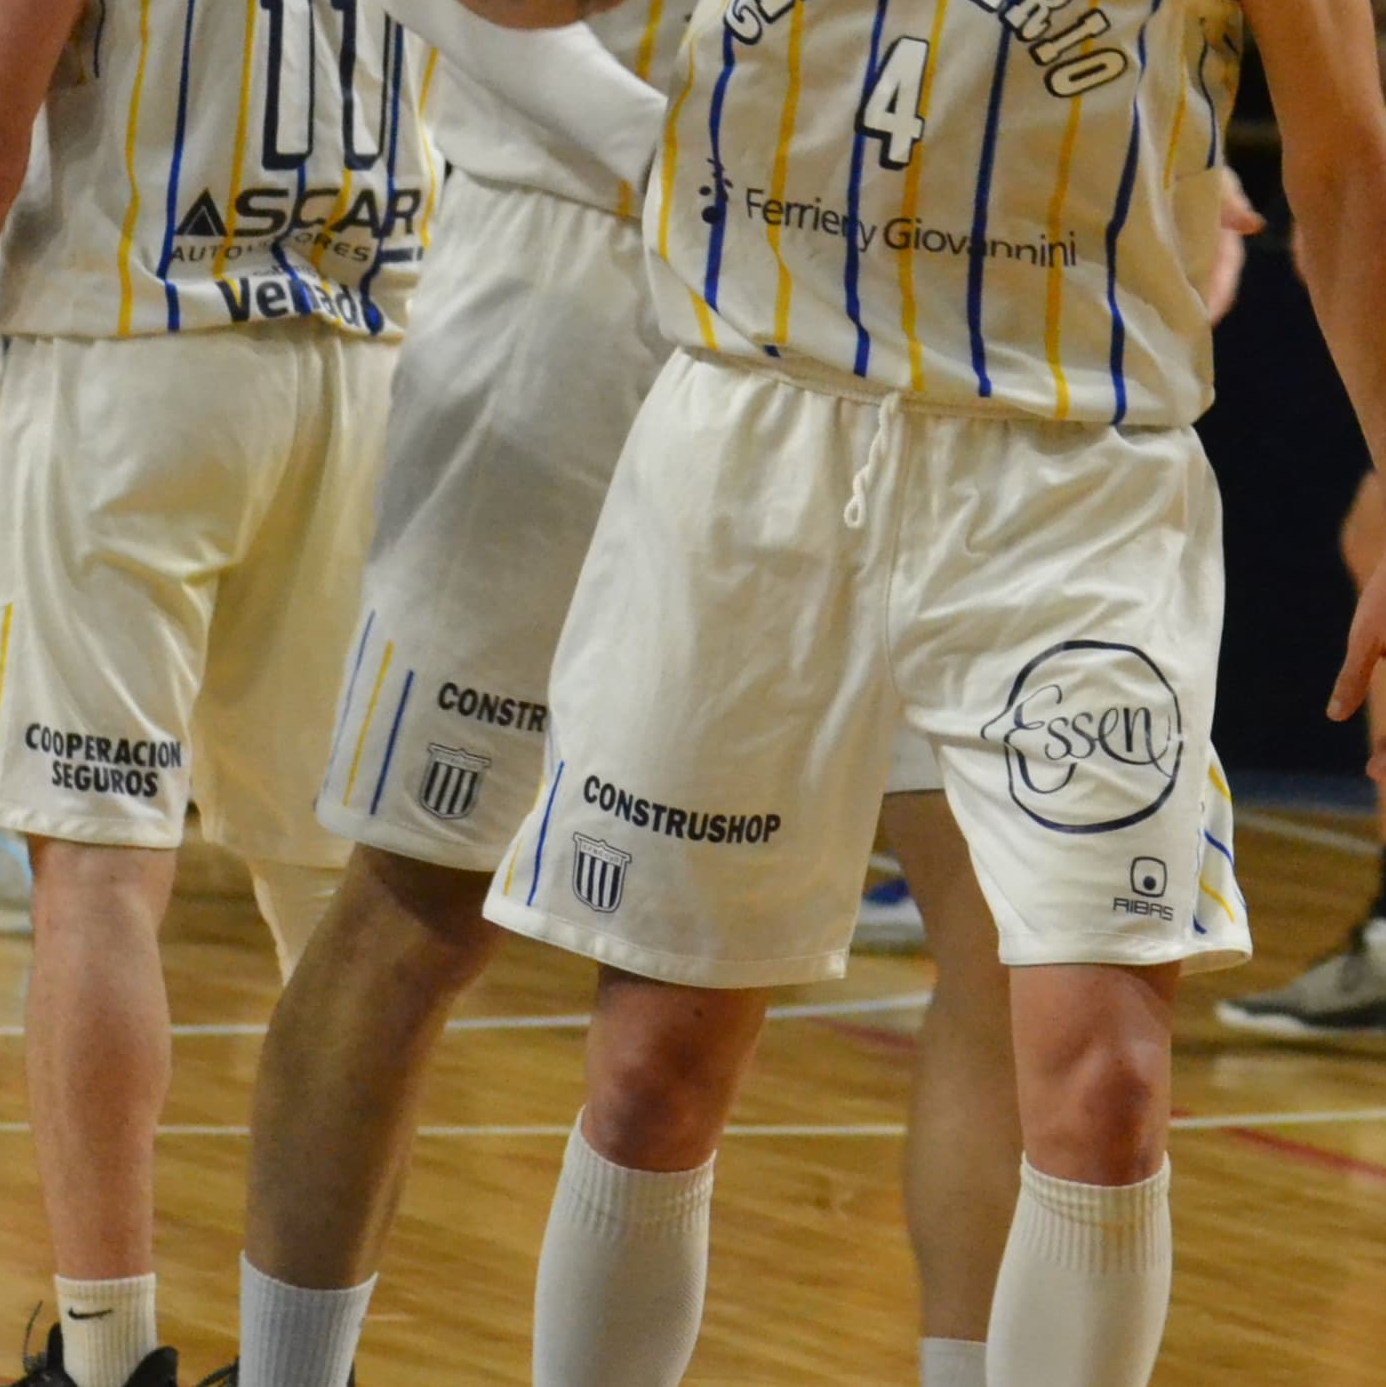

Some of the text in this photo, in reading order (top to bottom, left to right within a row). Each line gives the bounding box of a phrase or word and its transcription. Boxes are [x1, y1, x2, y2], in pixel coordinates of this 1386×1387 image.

[855, 36, 930, 170] 4
[883, 216, 1077, 266] Giovannini
[24, 722, 182, 768] COOPERACION
[980, 683, 1175, 795] Essen
[51, 760, 159, 797] SEGUROS
[583, 774, 782, 844] CONSTRUSHOP
[1113, 896, 1175, 922] RIBAS
